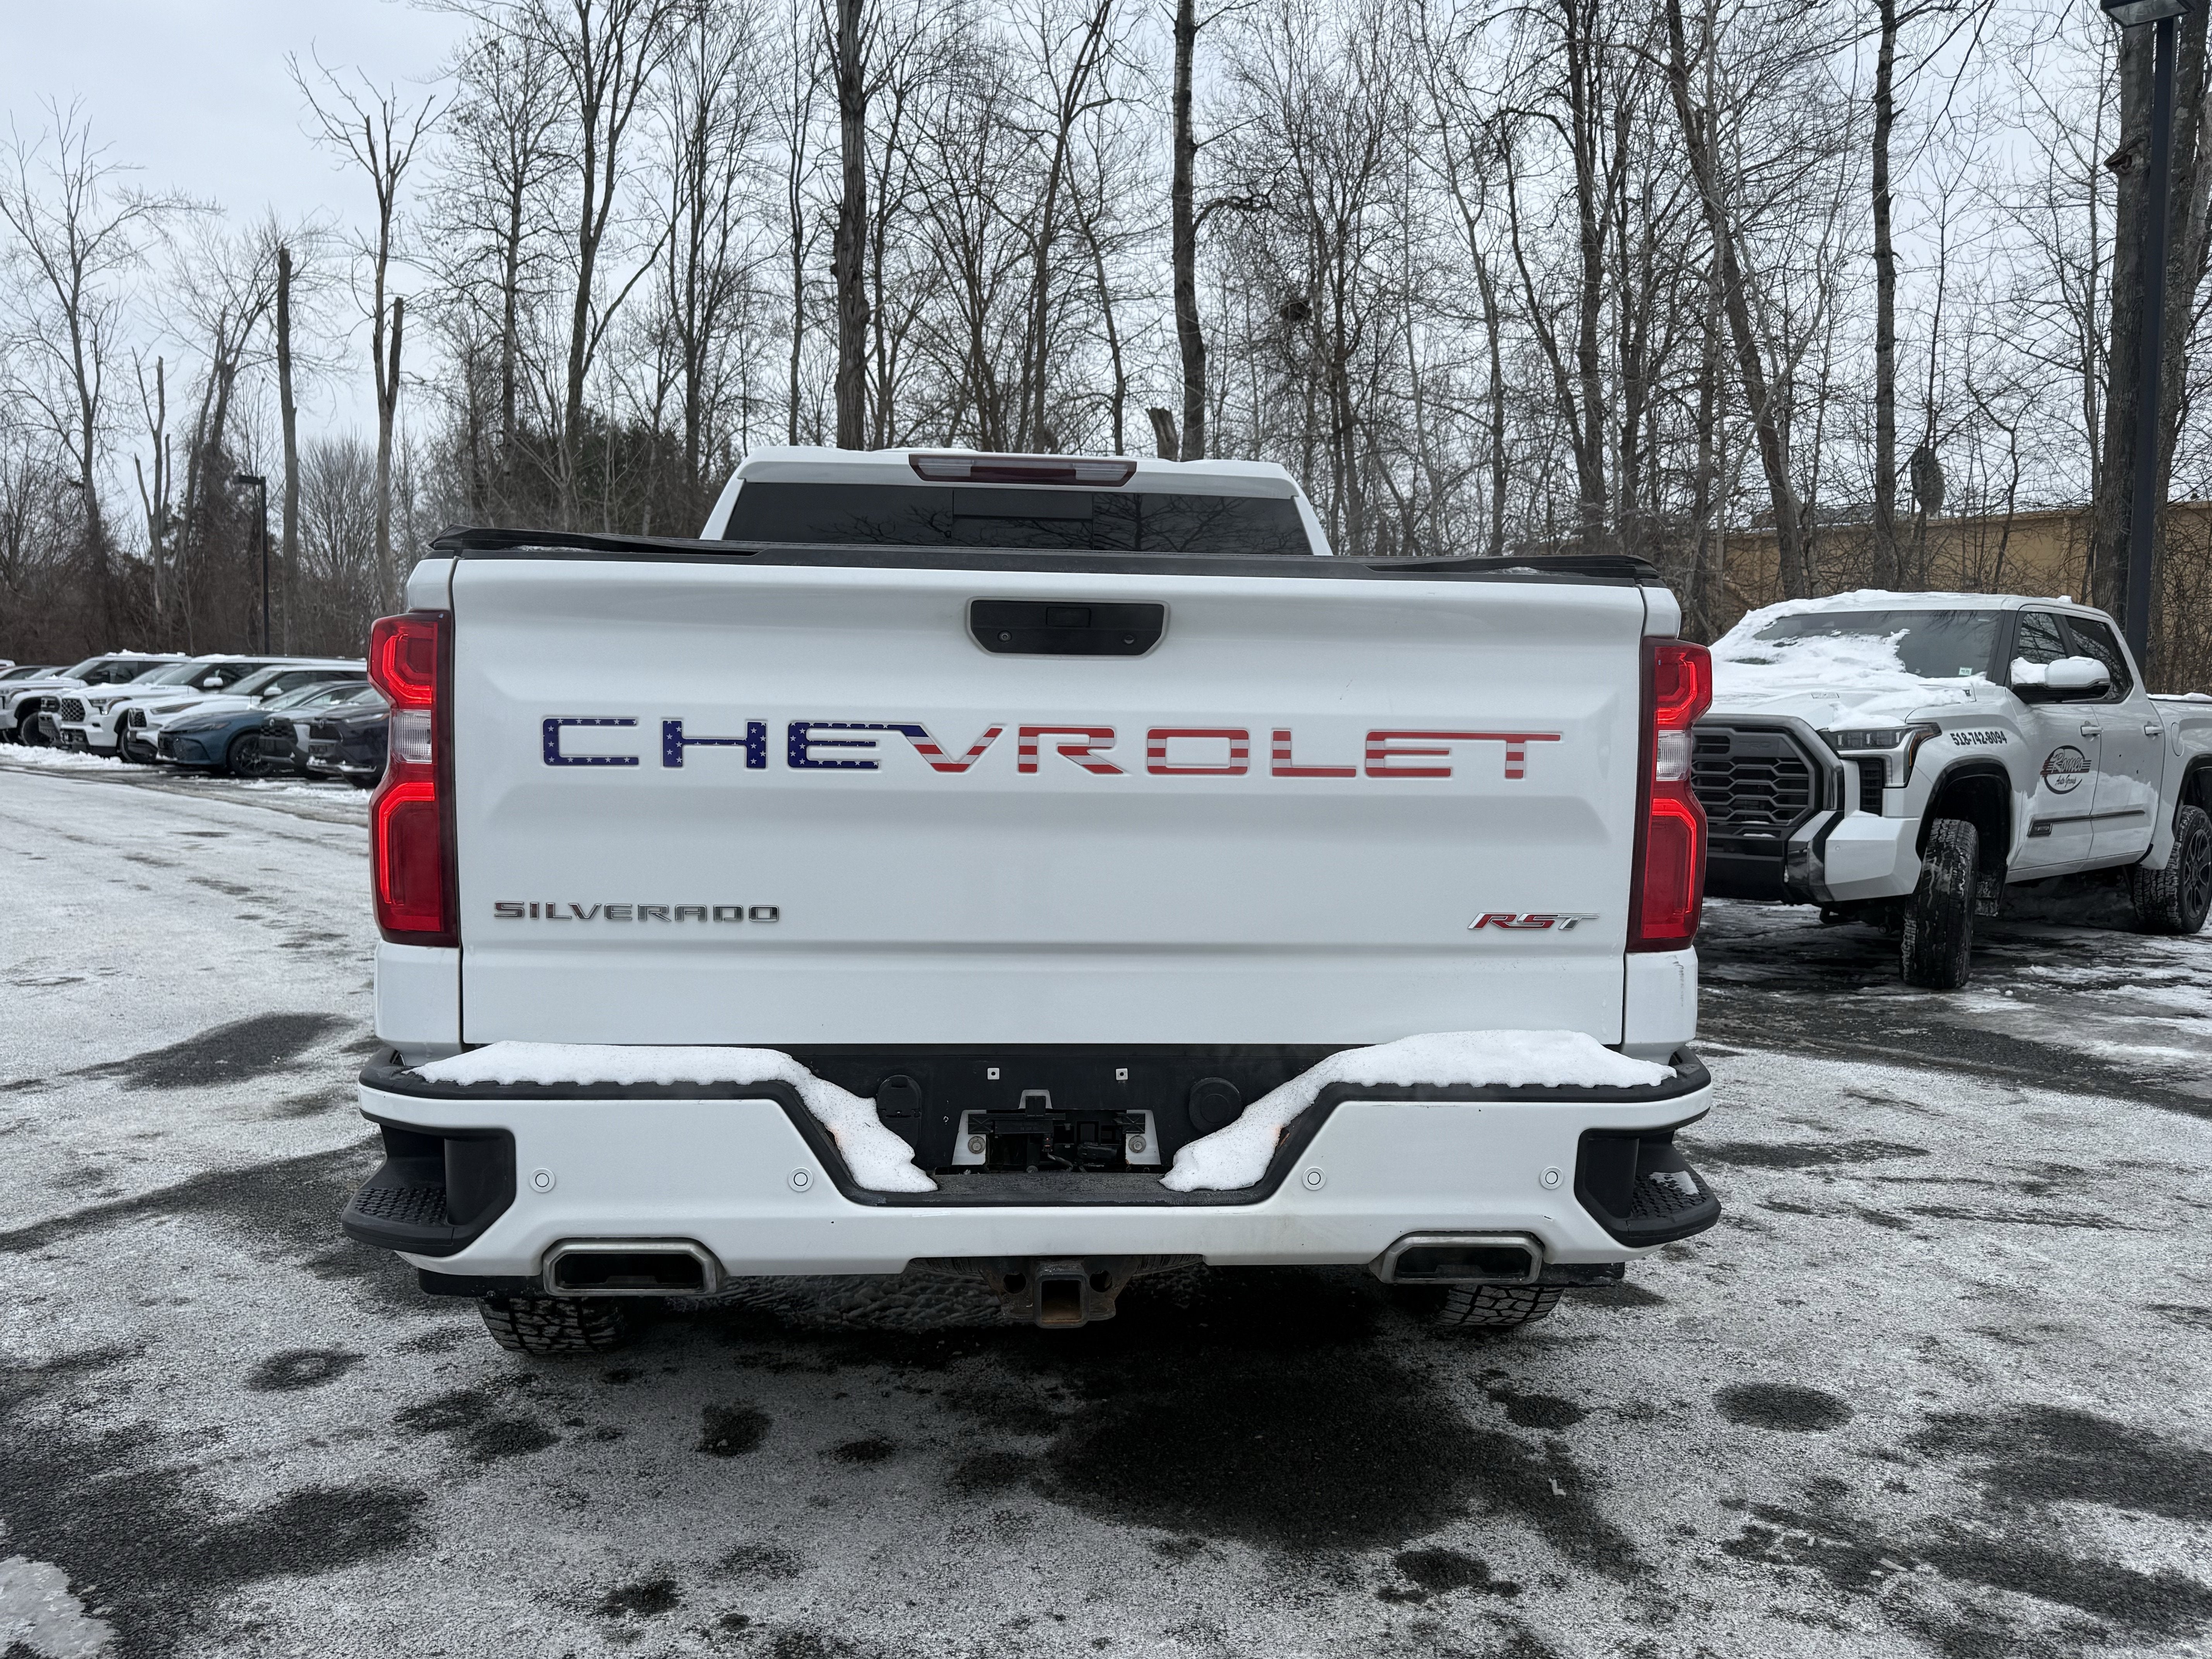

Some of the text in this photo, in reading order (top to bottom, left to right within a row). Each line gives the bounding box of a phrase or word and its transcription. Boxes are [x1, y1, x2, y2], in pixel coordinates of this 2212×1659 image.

[543, 718, 1561, 779] CHEVROLET
[1950, 731, 2007, 745] 518-742-8094
[2050, 749, 2083, 773] Romeo
[493, 900, 780, 922] SILVERADO
[1467, 912, 1600, 930] RST
